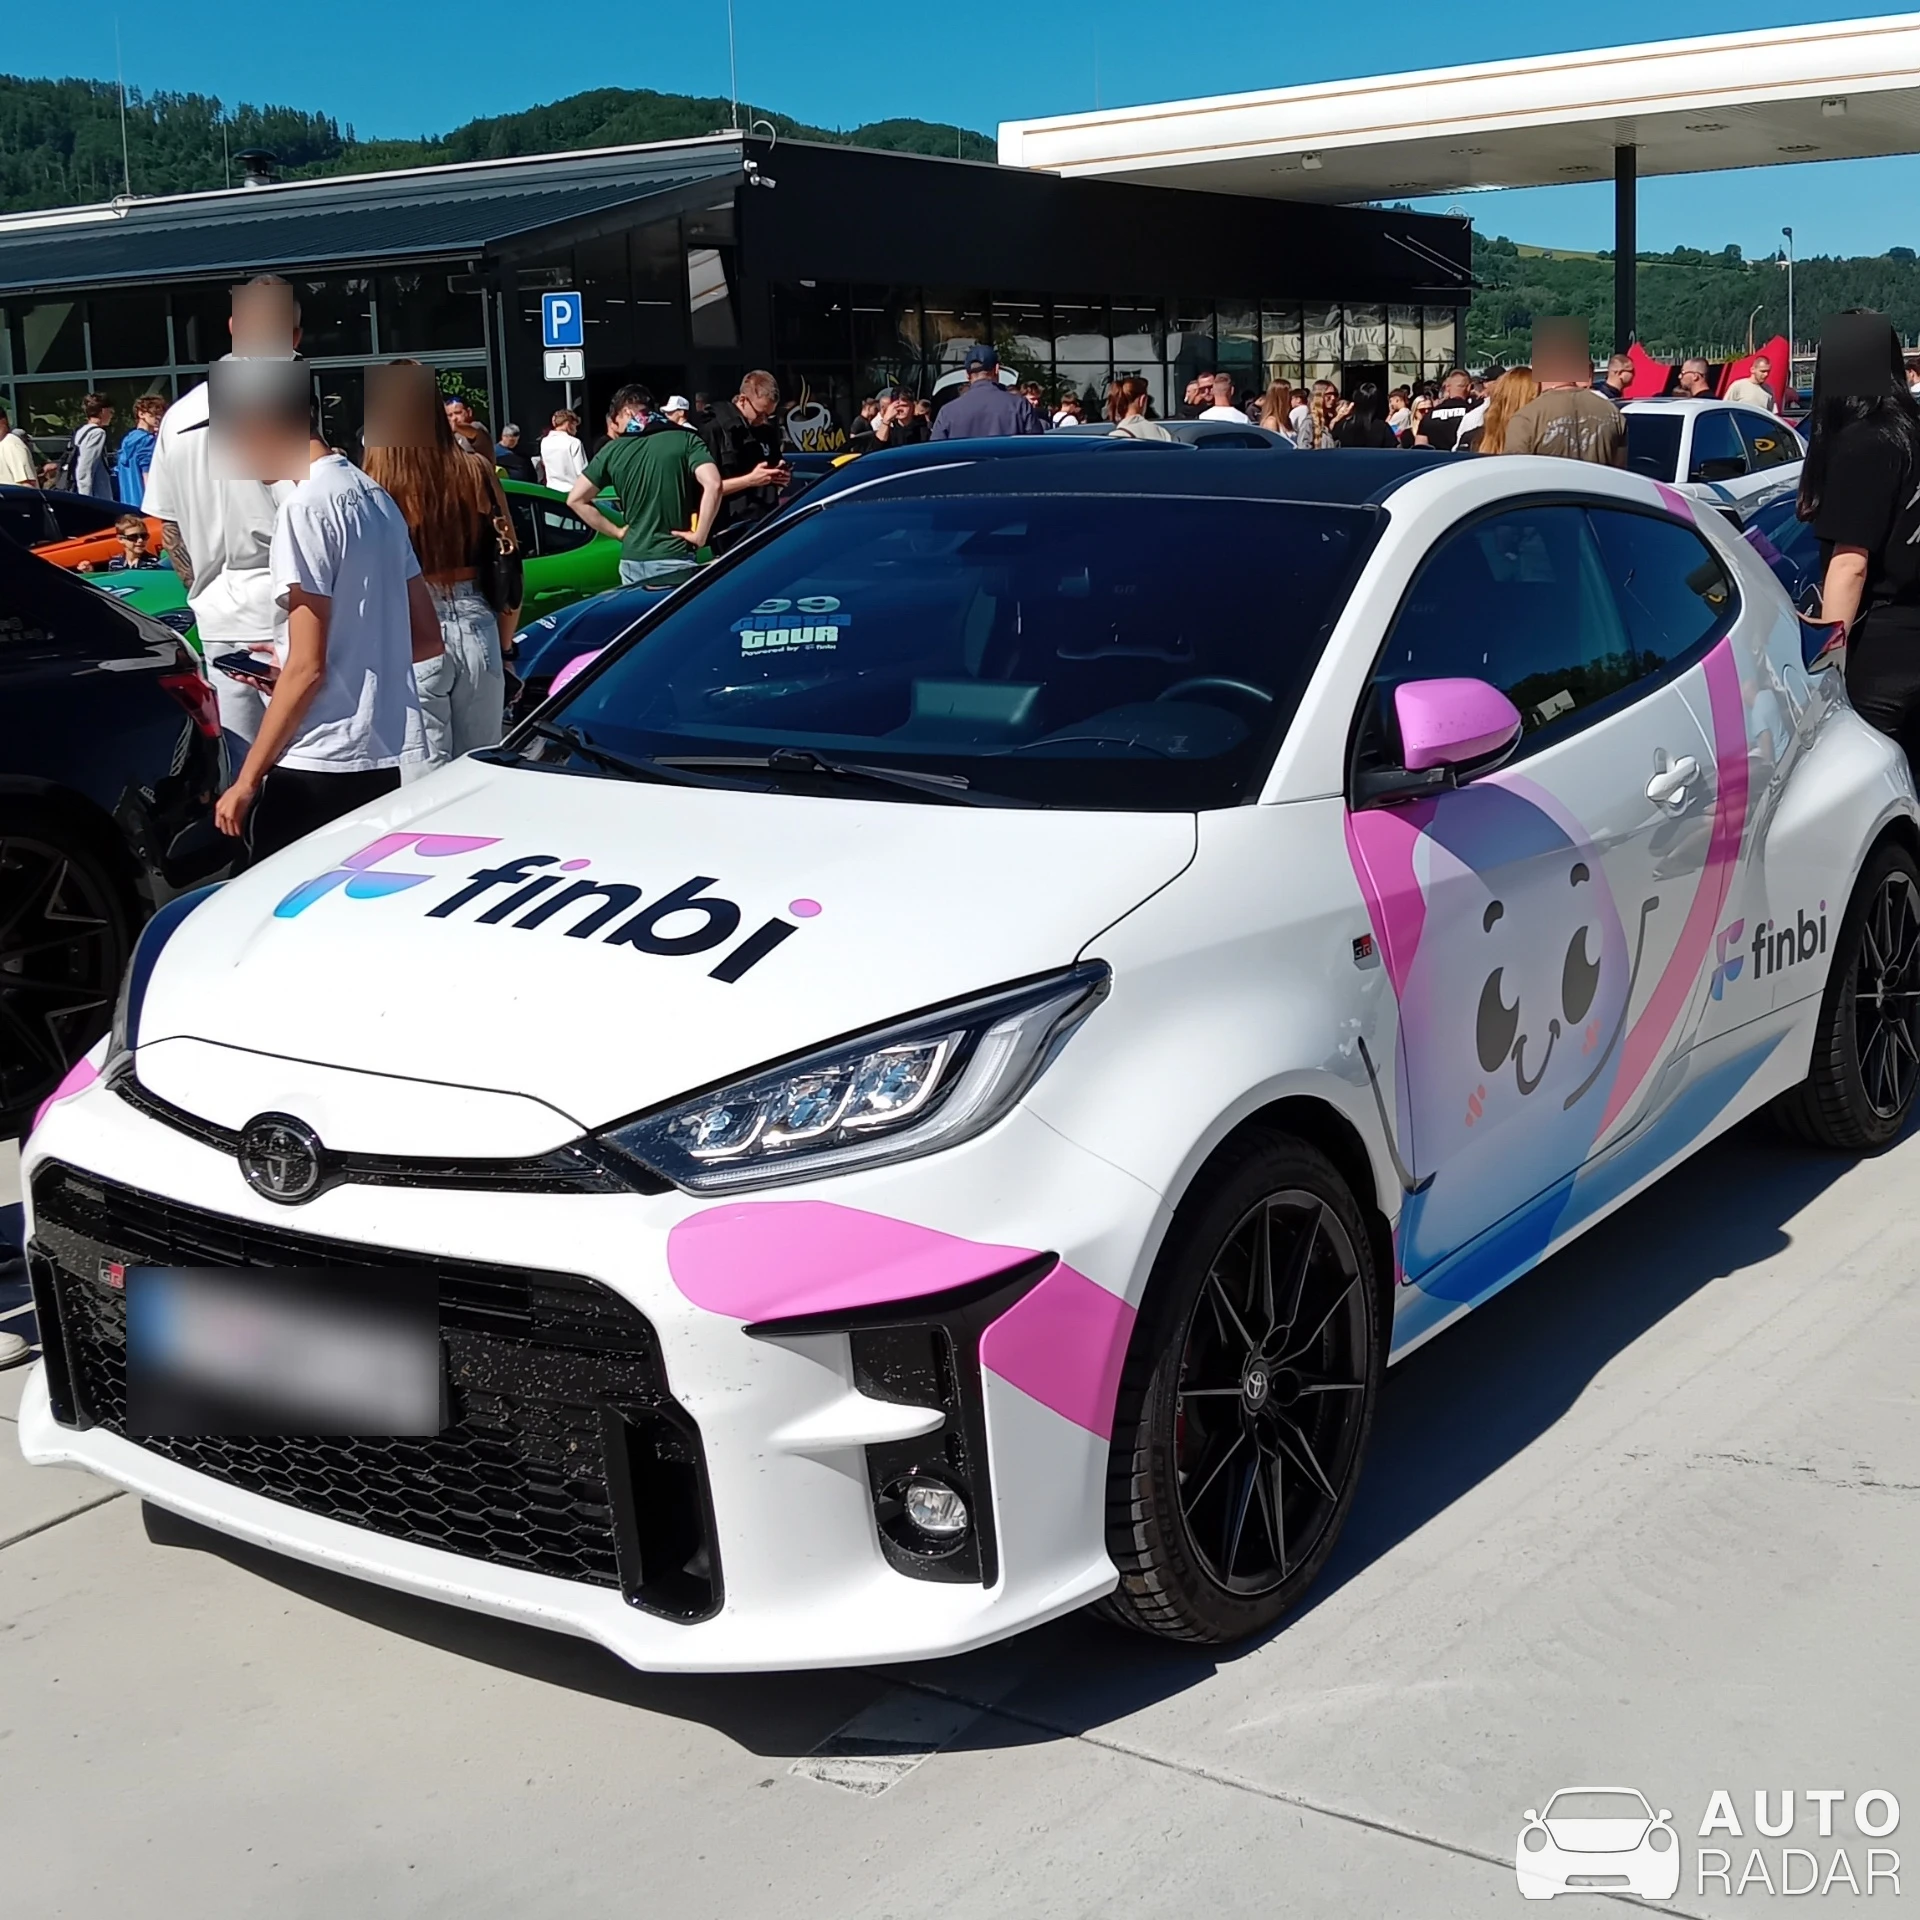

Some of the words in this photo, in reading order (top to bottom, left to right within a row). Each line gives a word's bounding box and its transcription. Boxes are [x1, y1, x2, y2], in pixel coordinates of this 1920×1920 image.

[552, 300, 572, 339] P
[750, 596, 840, 613] 99
[424, 855, 822, 983] finbi
[1751, 899, 1827, 980] finbi
[99, 1268, 124, 1289] GR
